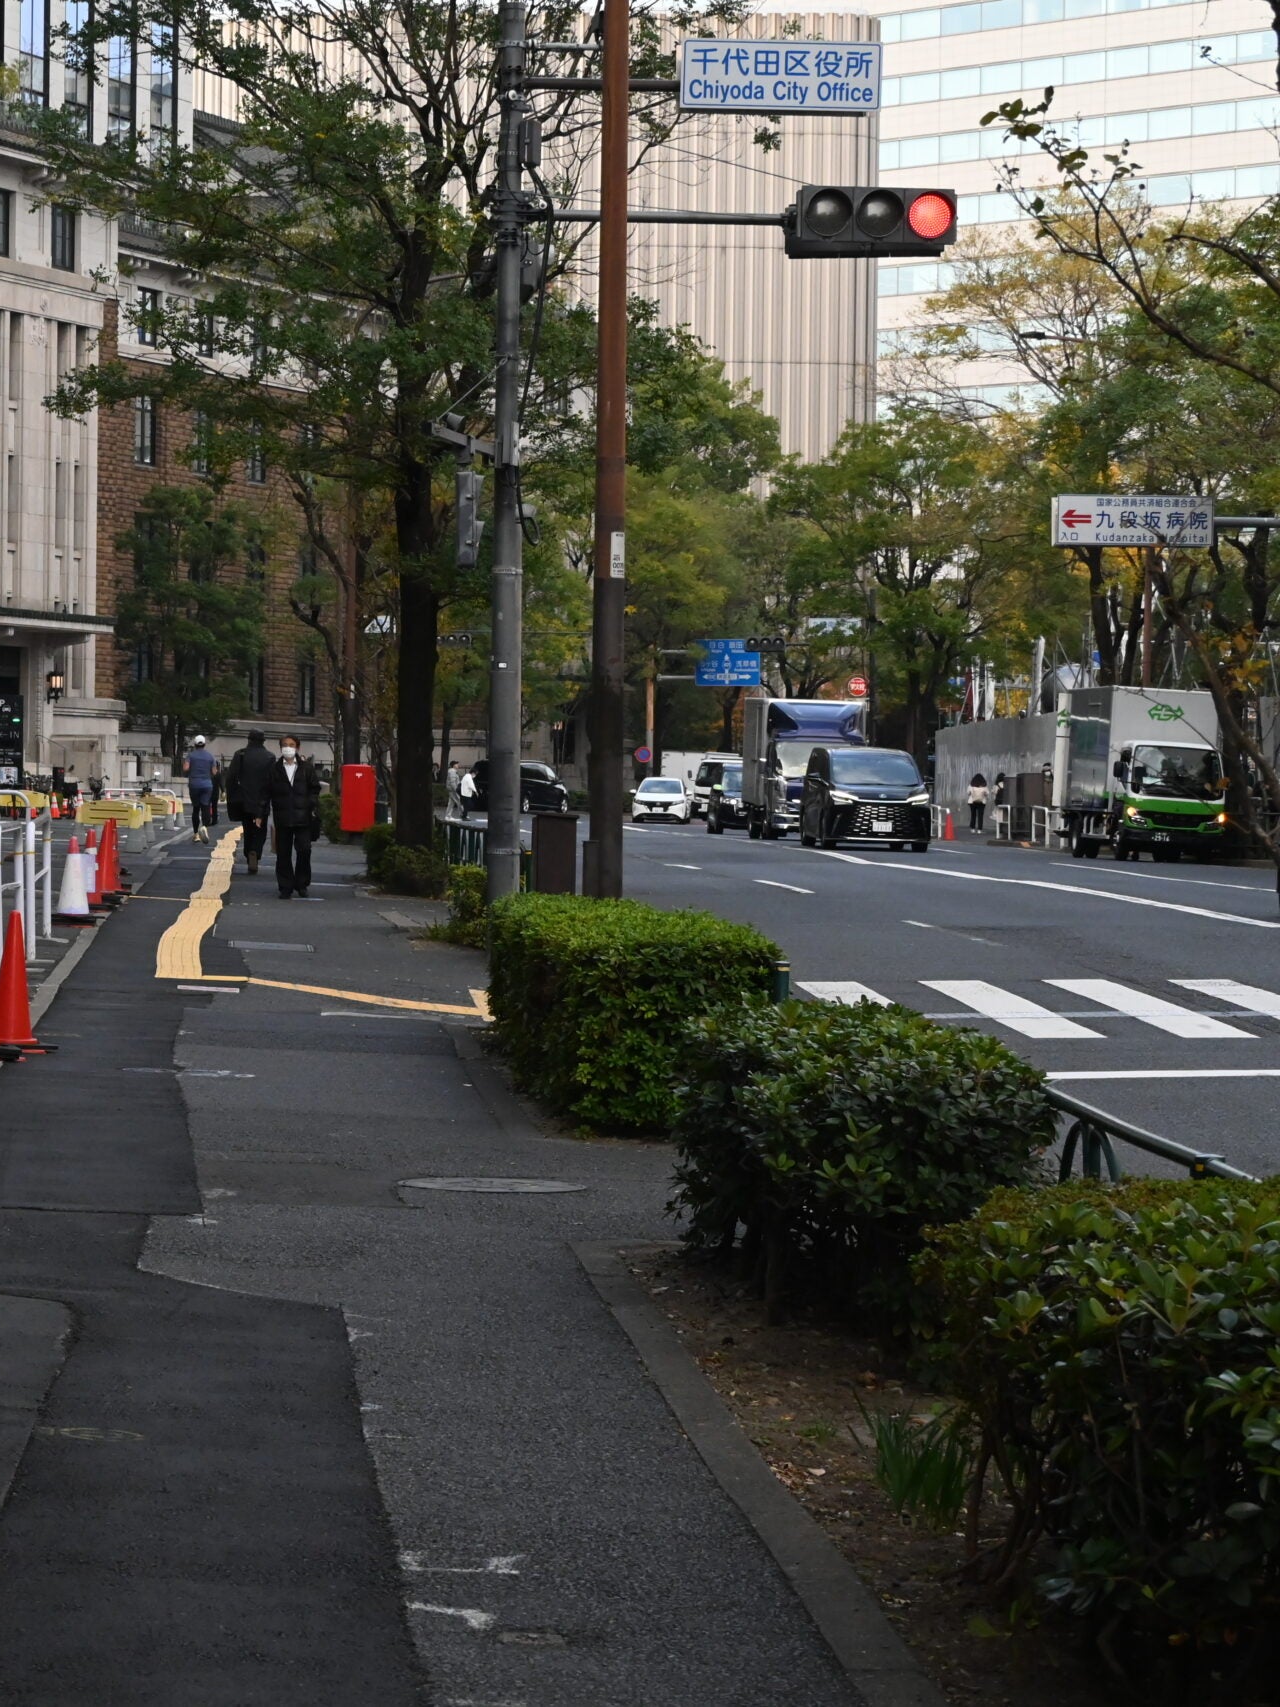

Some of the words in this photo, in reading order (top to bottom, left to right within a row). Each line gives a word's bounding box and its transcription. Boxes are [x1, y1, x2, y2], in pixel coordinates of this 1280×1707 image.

[691, 48, 873, 79] 千代田区役所
[689, 79, 765, 103] Chiyoda
[772, 81, 808, 104] City
[817, 82, 873, 102] Office
[1096, 511, 1208, 530] 九段坂病院
[1060, 532, 1079, 541] 入口
[1095, 533, 1154, 543] Kudanzaka
[0, 698, 6, 707] P
